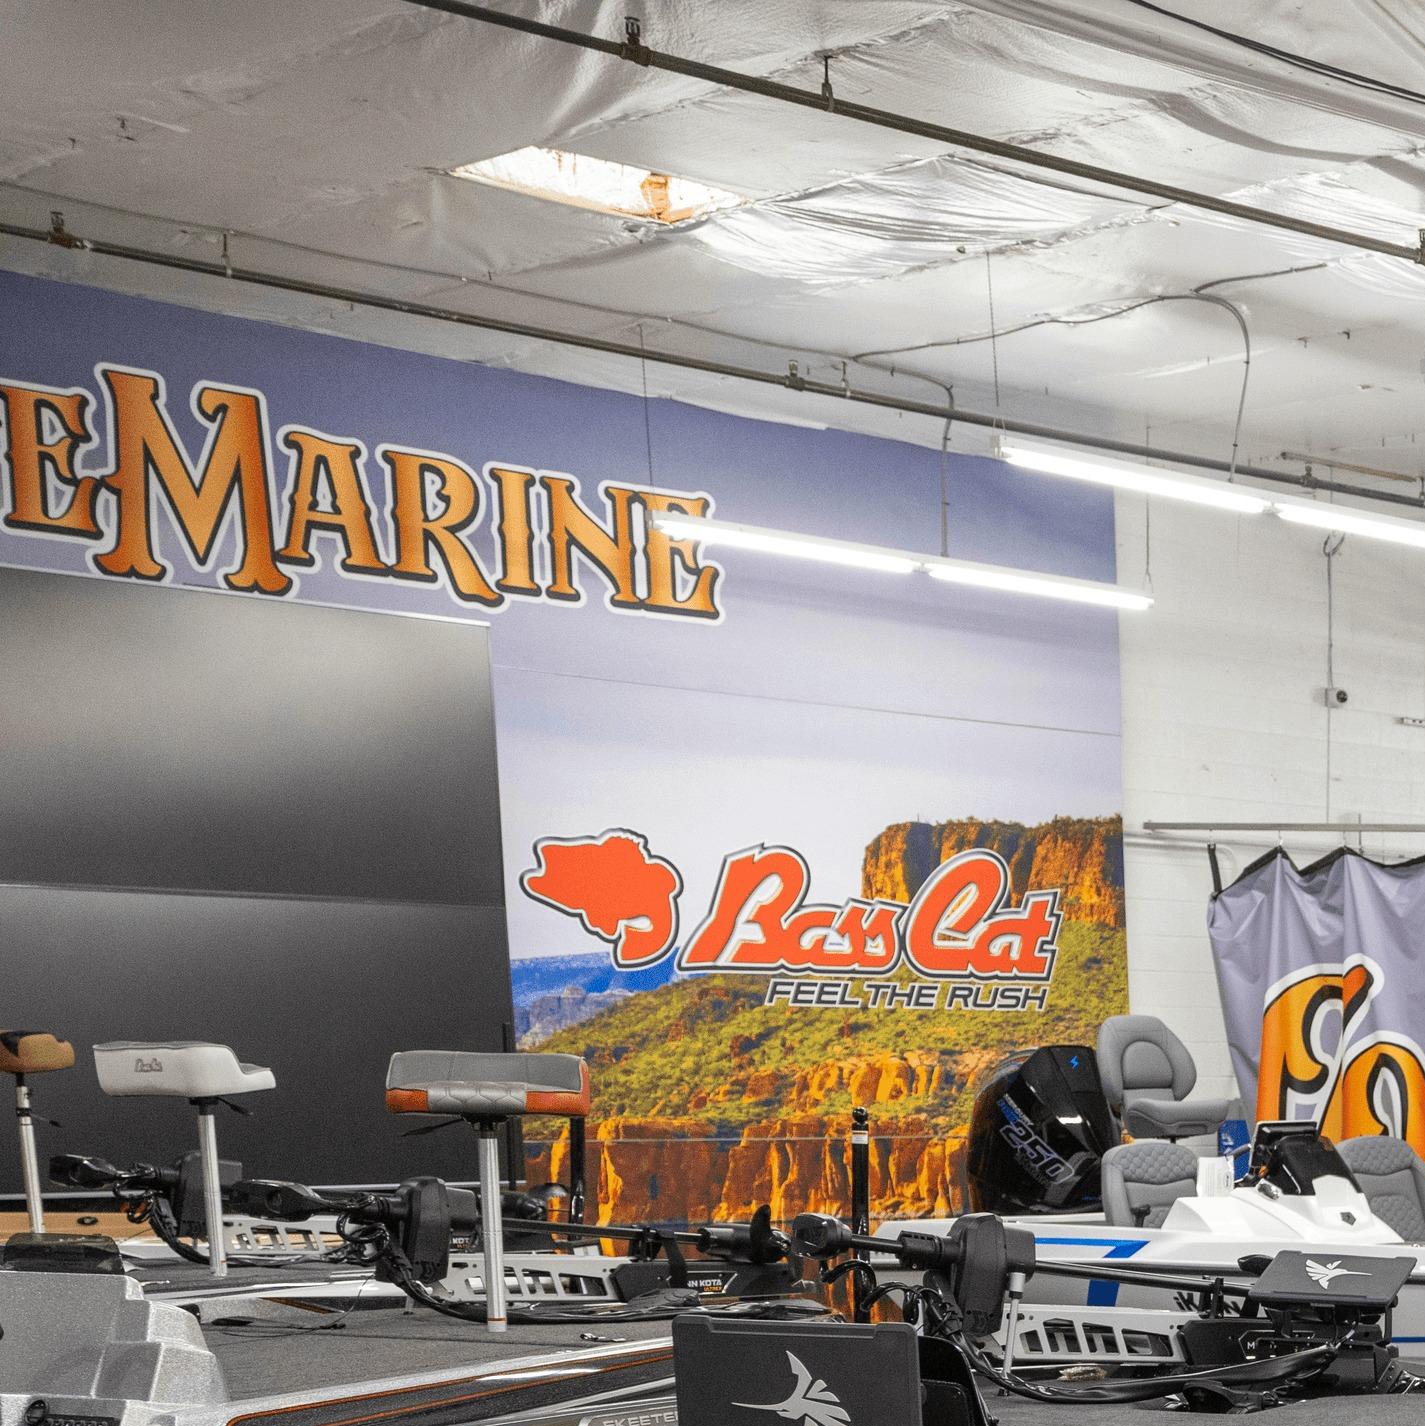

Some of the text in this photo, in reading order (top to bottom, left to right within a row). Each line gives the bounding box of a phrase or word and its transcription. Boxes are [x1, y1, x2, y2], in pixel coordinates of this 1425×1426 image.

[765, 980, 1048, 1011] FEEL THE RUSH
[1000, 1121, 1075, 1185] 250
